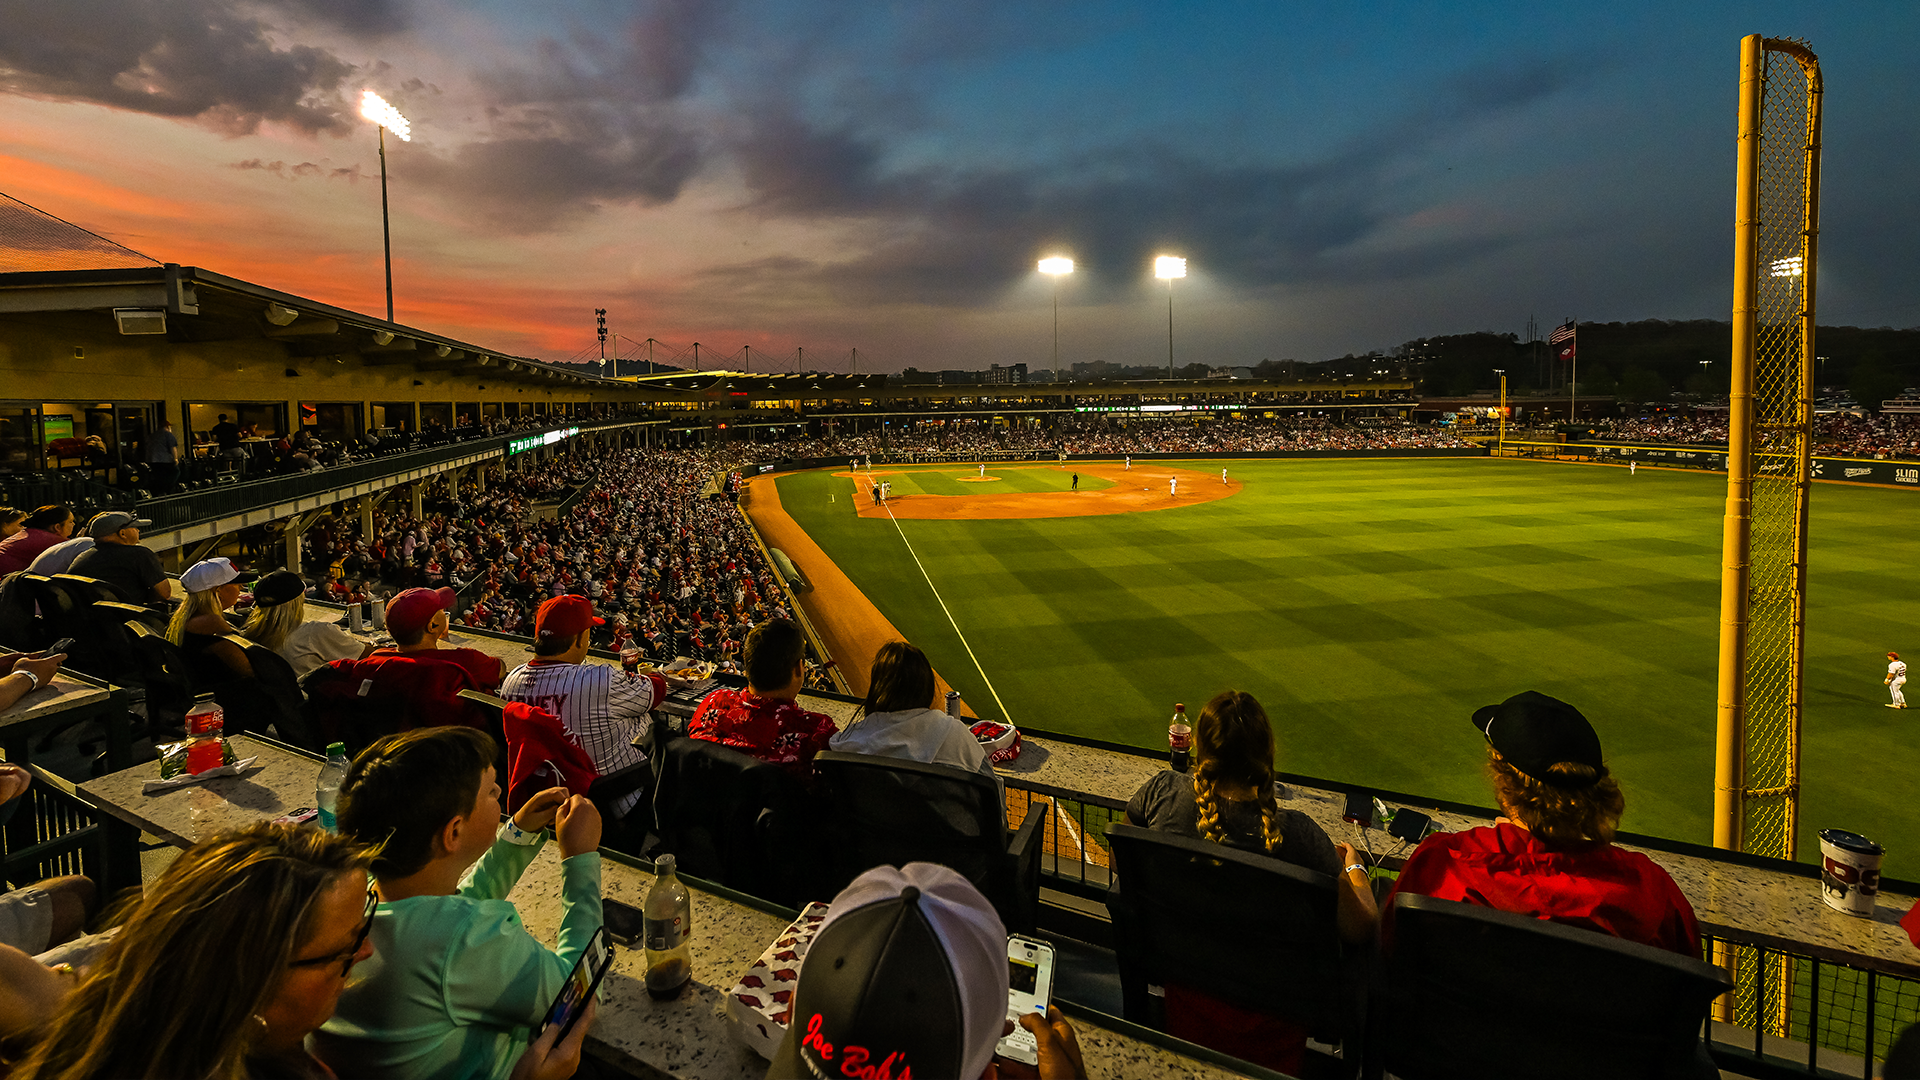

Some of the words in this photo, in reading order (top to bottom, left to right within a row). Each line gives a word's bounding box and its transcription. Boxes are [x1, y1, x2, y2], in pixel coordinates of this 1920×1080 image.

[1895, 468, 1919, 478] SLIM
[802, 1012, 834, 1060] Joe
[840, 1045, 913, 1080] Bob's
